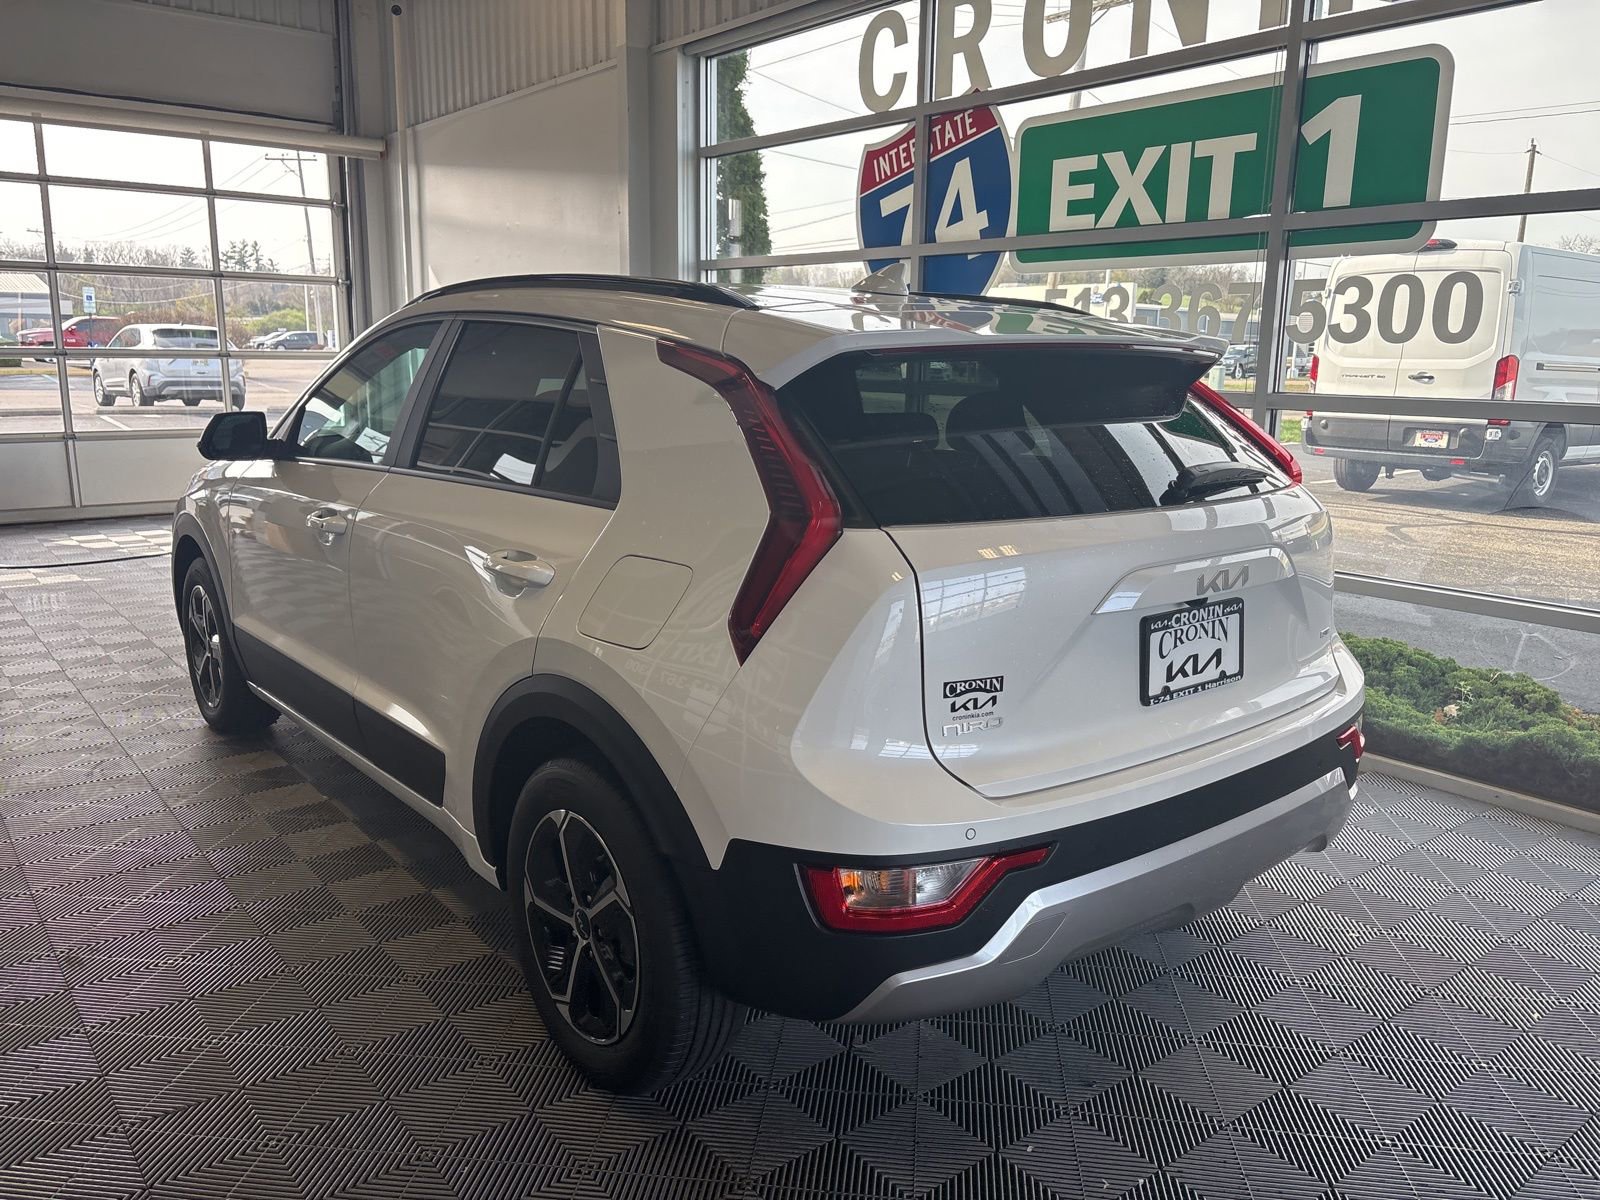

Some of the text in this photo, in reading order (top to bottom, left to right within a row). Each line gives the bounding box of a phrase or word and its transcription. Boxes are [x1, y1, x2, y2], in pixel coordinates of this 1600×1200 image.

[859, 0, 1396, 112] CRON
[873, 109, 977, 182] INTETATE
[1049, 94, 1363, 232] EXIT 1
[880, 156, 989, 260] 74
[1045, 270, 1484, 345] 13-3675300
[1196, 565, 1249, 596] KIA
[1171, 604, 1223, 628] CRONIN
[1158, 616, 1230, 660] CRONIN
[1166, 647, 1222, 683] KIA
[945, 678, 1001, 697] CRONIN
[950, 695, 998, 713] KIA
[1150, 692, 1171, 705] I-74
[1172, 687, 1195, 699] EXIT
[1204, 674, 1242, 690] Harrison
[942, 717, 1003, 737] NIRO
[952, 710, 995, 721] croninkia.com
